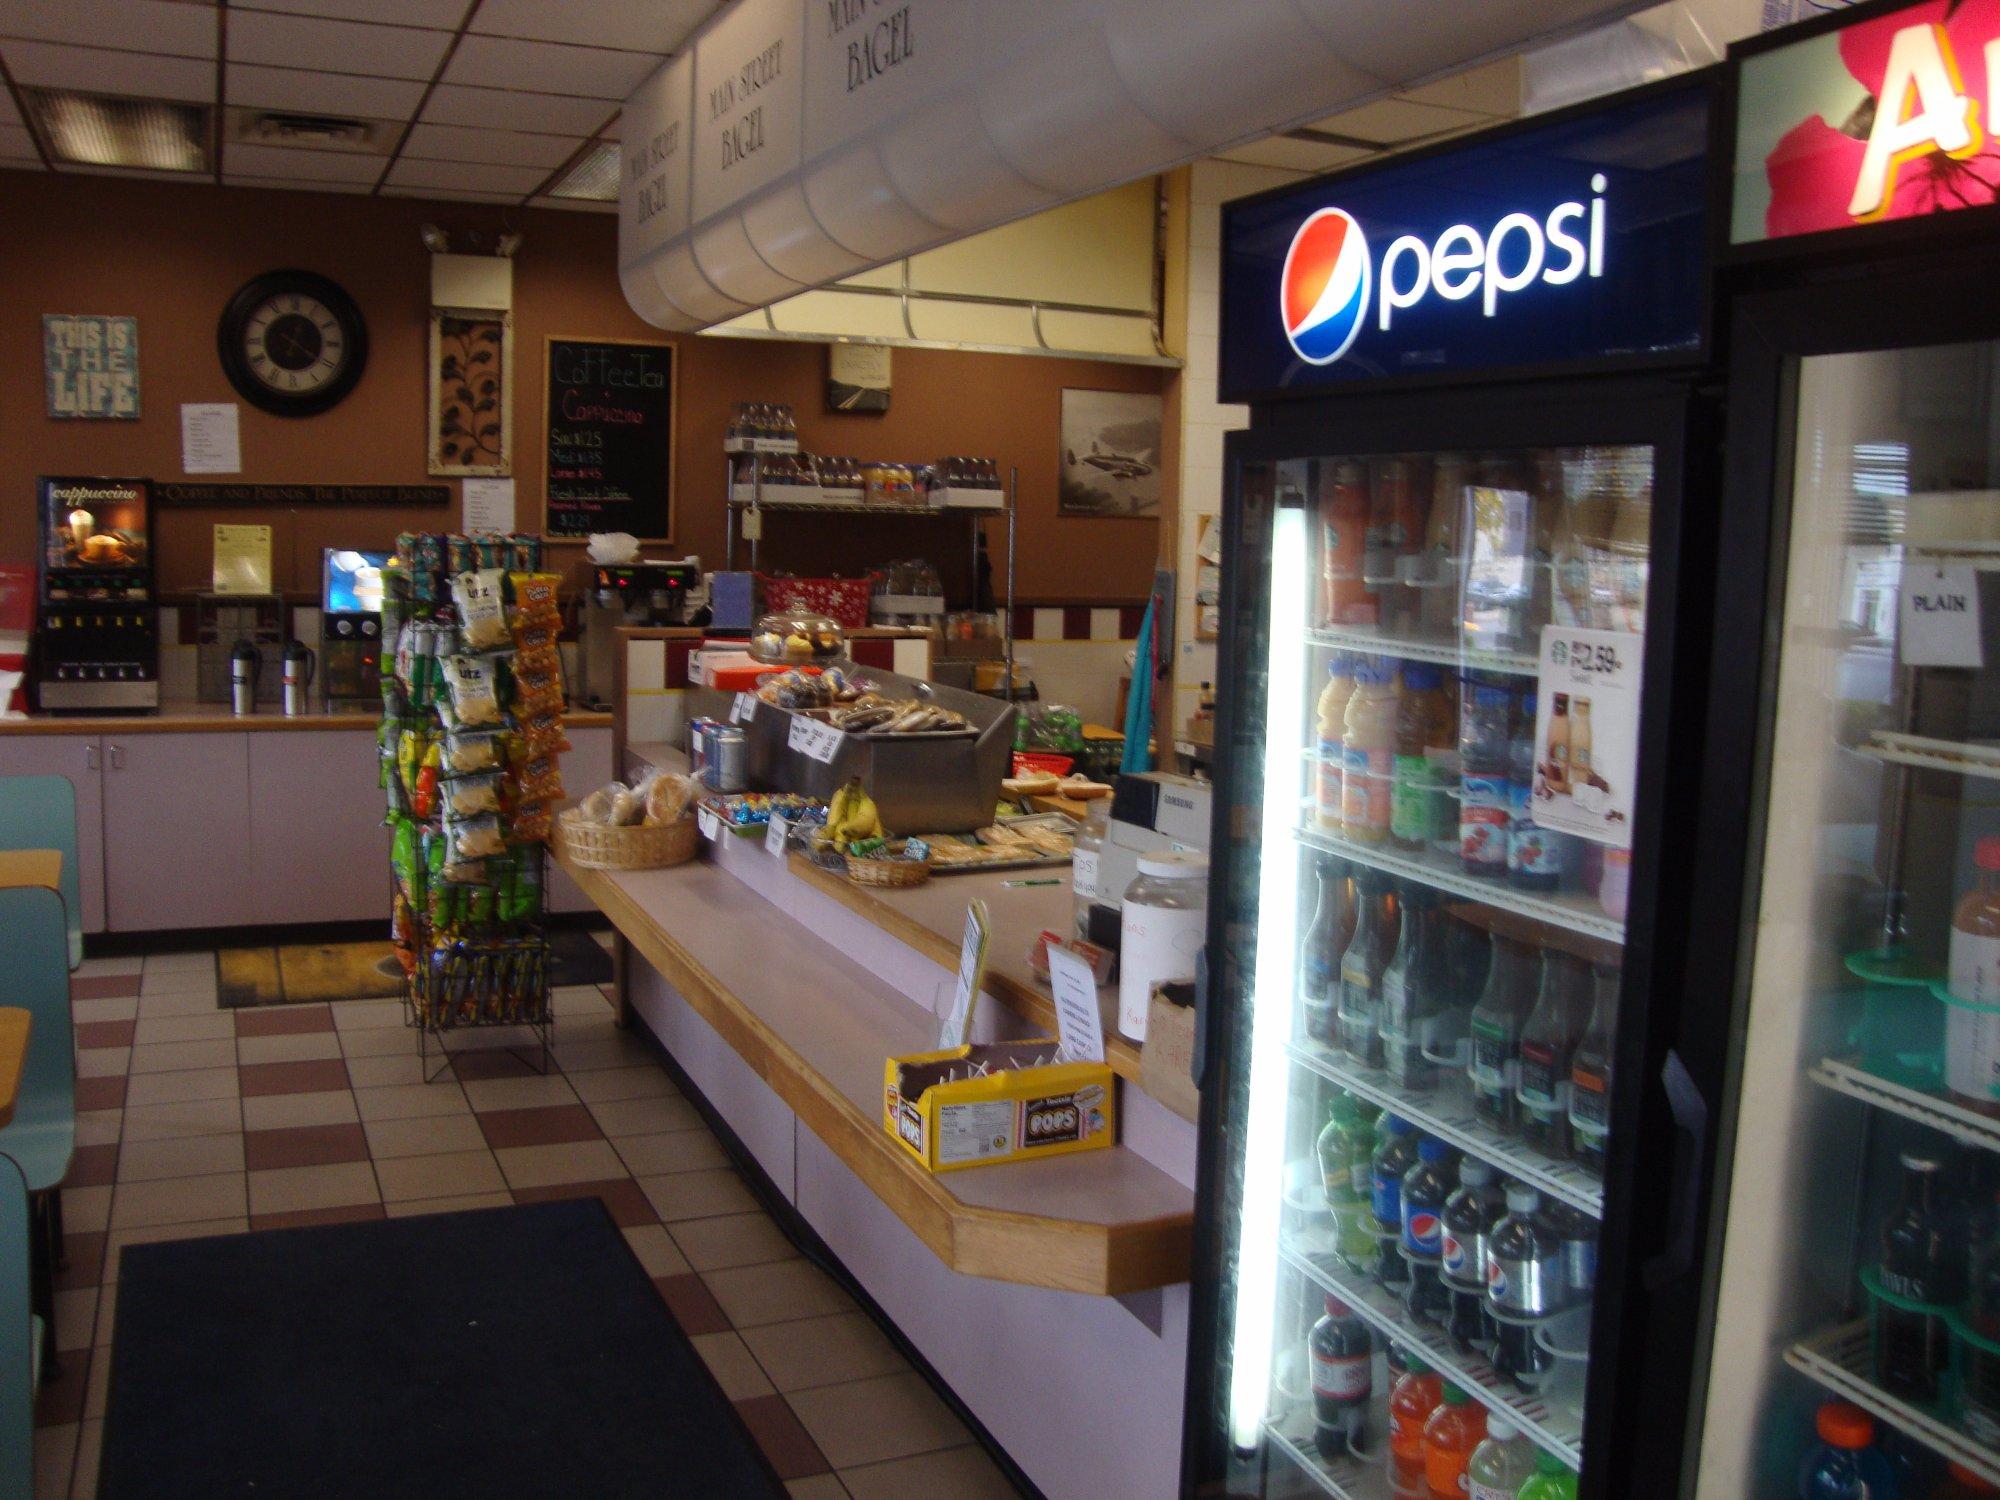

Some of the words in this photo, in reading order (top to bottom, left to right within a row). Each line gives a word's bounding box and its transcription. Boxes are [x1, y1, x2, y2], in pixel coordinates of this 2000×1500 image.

[846, 5, 913, 93] BAGEL
[709, 74, 736, 122] MAIN
[736, 39, 783, 101] STREET
[720, 105, 765, 170] BAGEL
[638, 174, 667, 223] BAGEL
[1379, 173, 1607, 331] pepsi
[51, 320, 101, 349] THIS
[106, 321, 129, 349] IS
[54, 348, 129, 371] THE
[53, 371, 133, 412] LIFE
[52, 485, 139, 506] cappuccino
[1911, 592, 1967, 613] PLAIN
[1164, 794, 1194, 810] SAMSUNG
[1030, 1108, 1077, 1134] POPS
